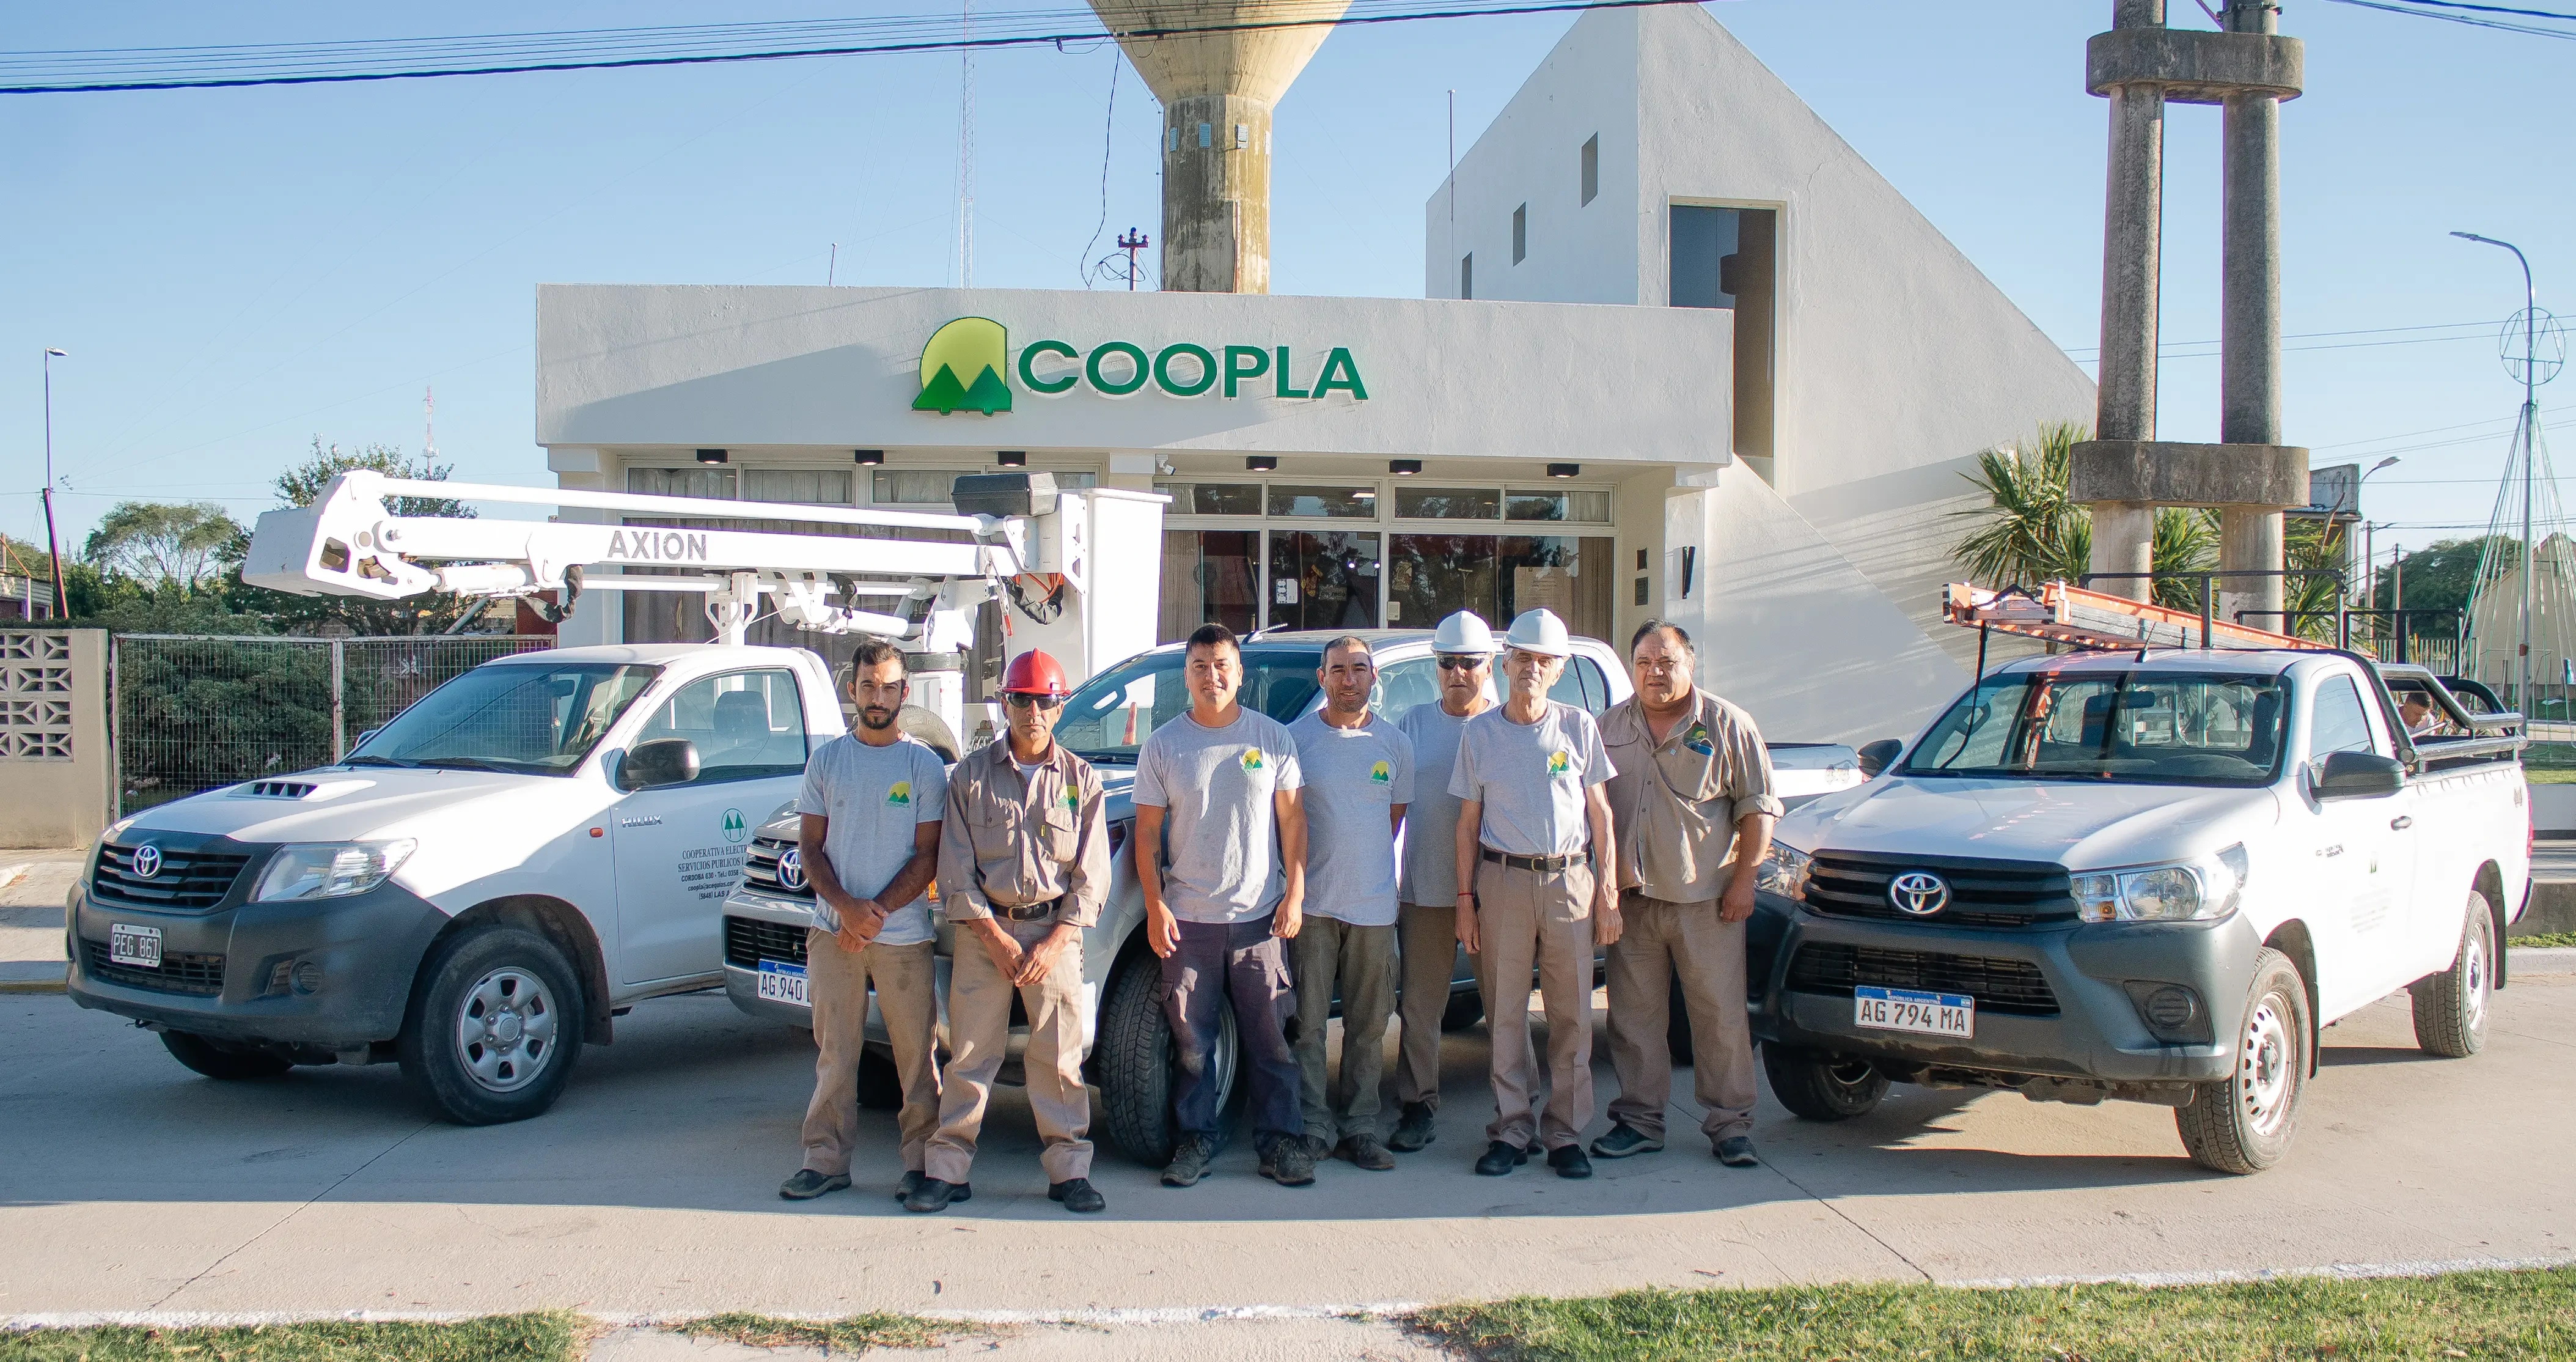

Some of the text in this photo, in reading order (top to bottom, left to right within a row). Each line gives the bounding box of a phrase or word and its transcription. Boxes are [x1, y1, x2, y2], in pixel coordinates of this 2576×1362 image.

[1018, 340, 1368, 400] COOPLA
[607, 530, 706, 561] AXION
[622, 814, 662, 828] HILUX
[678, 860, 711, 873] SERVICIOS
[711, 856, 741, 869] PUBLICOS
[682, 844, 747, 860] COOPERATIVA ELECTR
[681, 873, 704, 882] CORDOBA
[113, 933, 158, 960] PEG 861
[761, 973, 777, 996] AG
[780, 977, 802, 1001] 940
[1860, 999, 1965, 1032] AG 794 MA
